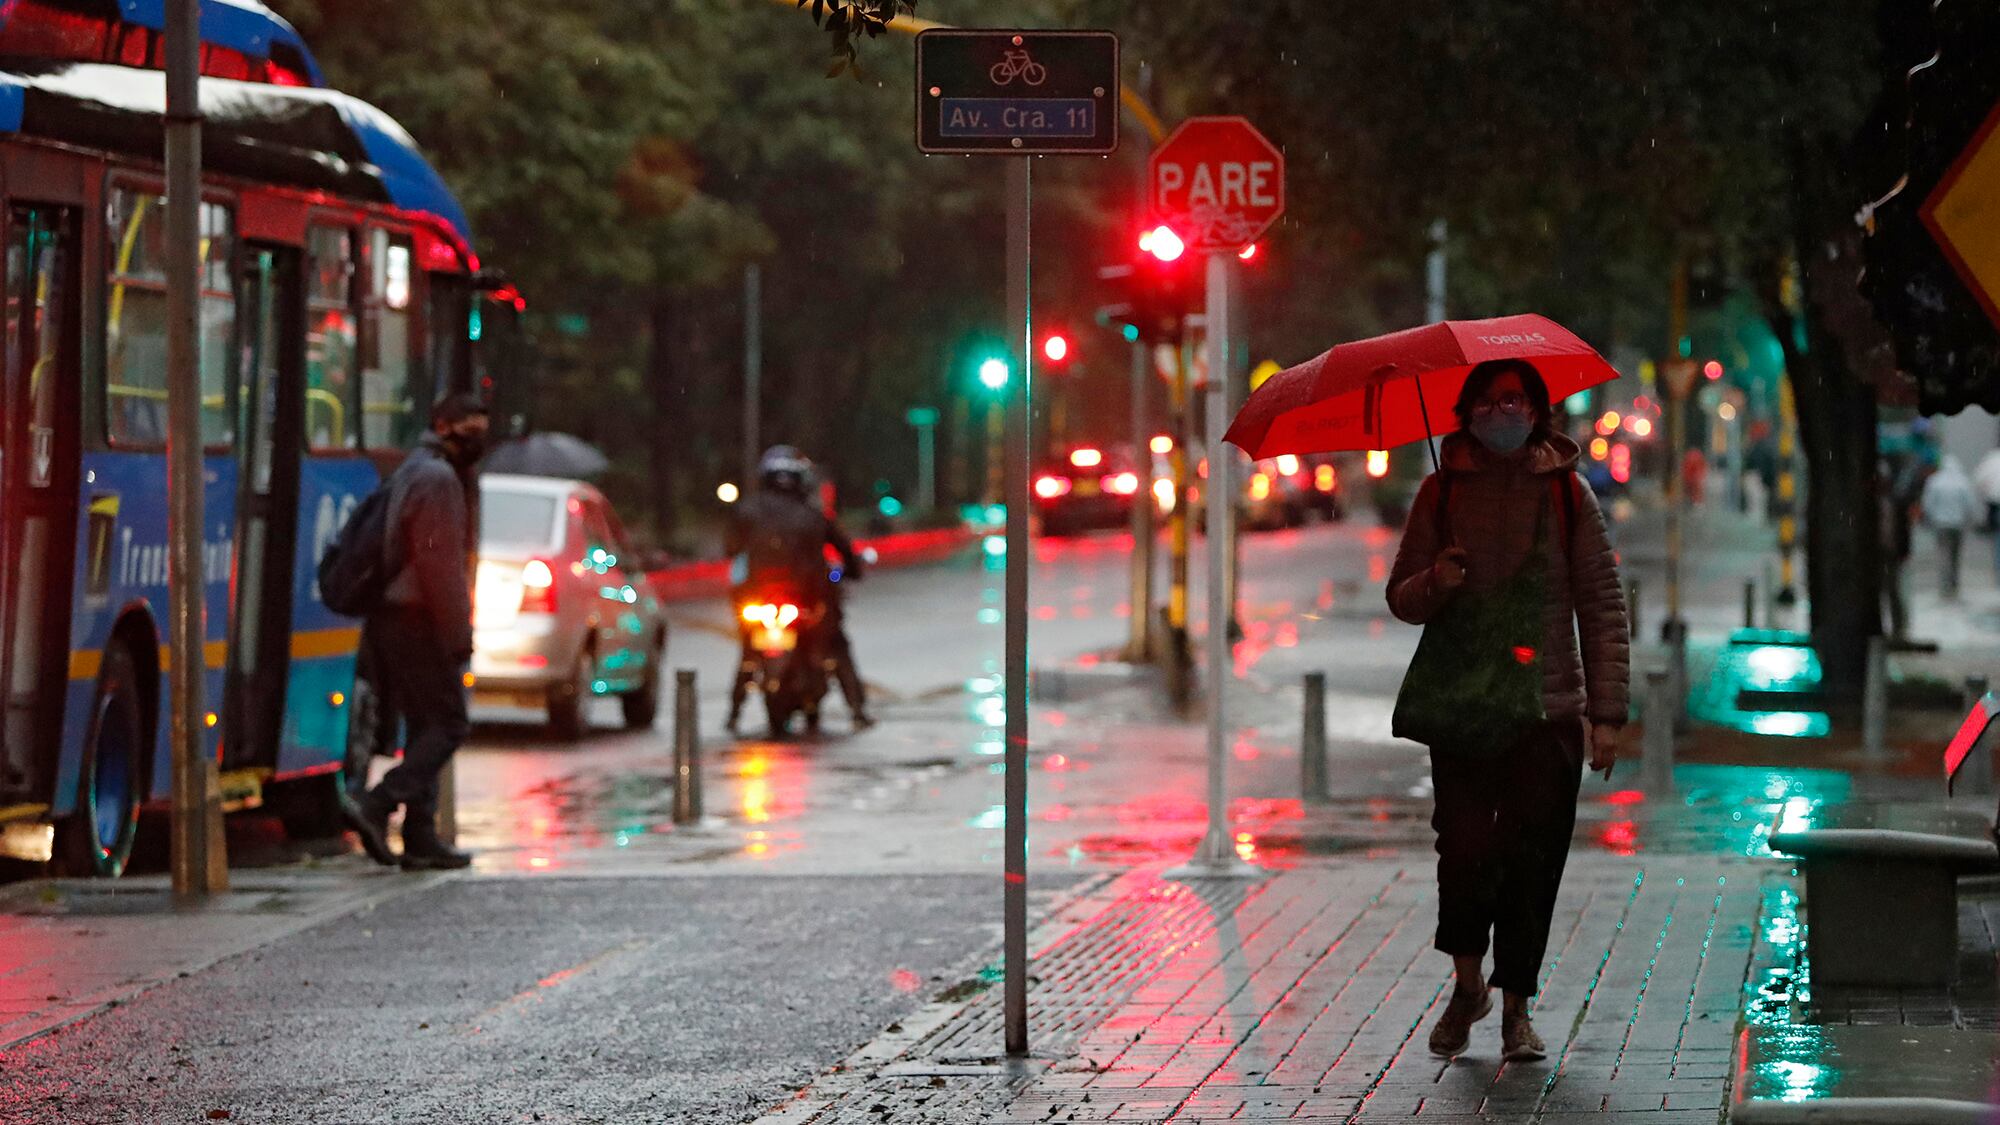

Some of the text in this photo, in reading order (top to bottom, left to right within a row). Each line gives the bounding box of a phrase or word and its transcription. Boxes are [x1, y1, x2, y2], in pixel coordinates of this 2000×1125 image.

[949, 106, 1088, 129] Av. Cra. 11
[1158, 161, 1276, 207] PARE
